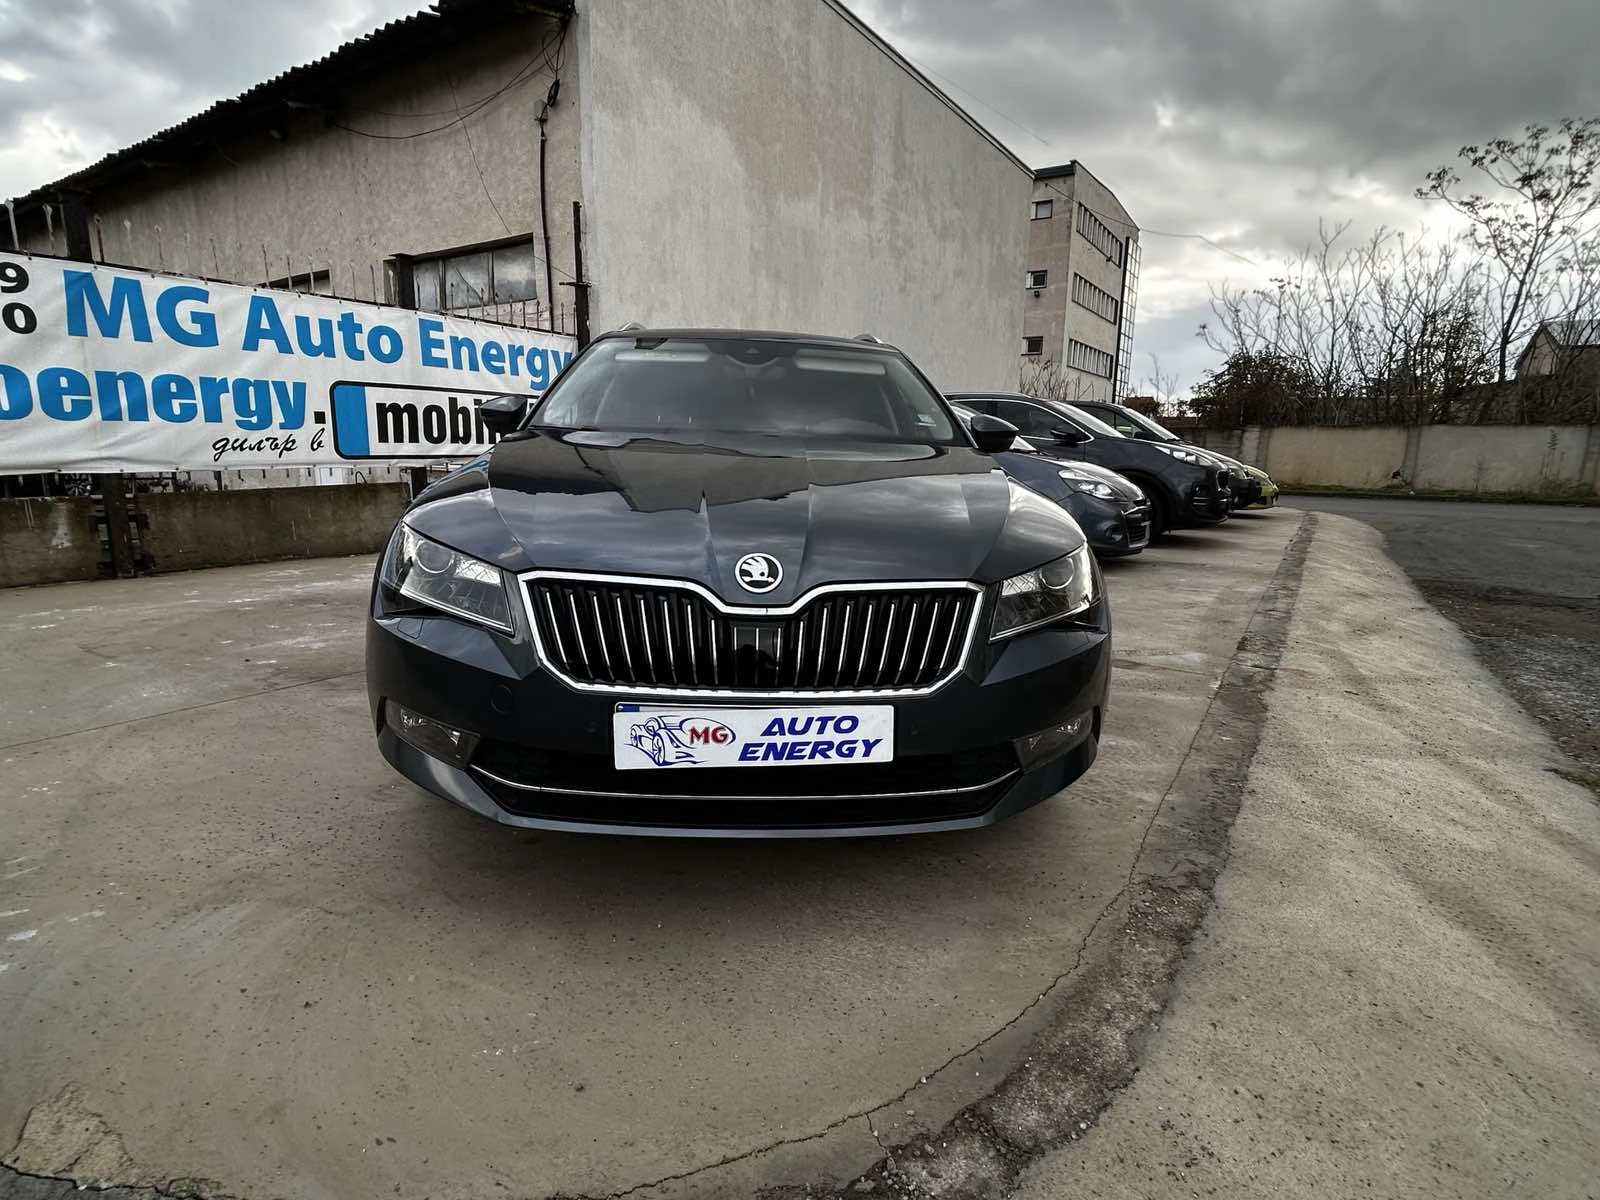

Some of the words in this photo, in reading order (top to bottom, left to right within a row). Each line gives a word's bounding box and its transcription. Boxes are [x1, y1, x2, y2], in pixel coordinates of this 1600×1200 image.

[0, 262, 29, 293] 9
[63, 269, 219, 348] MG
[242, 295, 403, 364] Auto
[212, 434, 297, 462] дилър
[310, 427, 325, 452] в
[689, 726, 729, 745] MG
[760, 715, 860, 737] AUTO
[738, 739, 884, 762] ENERGY
